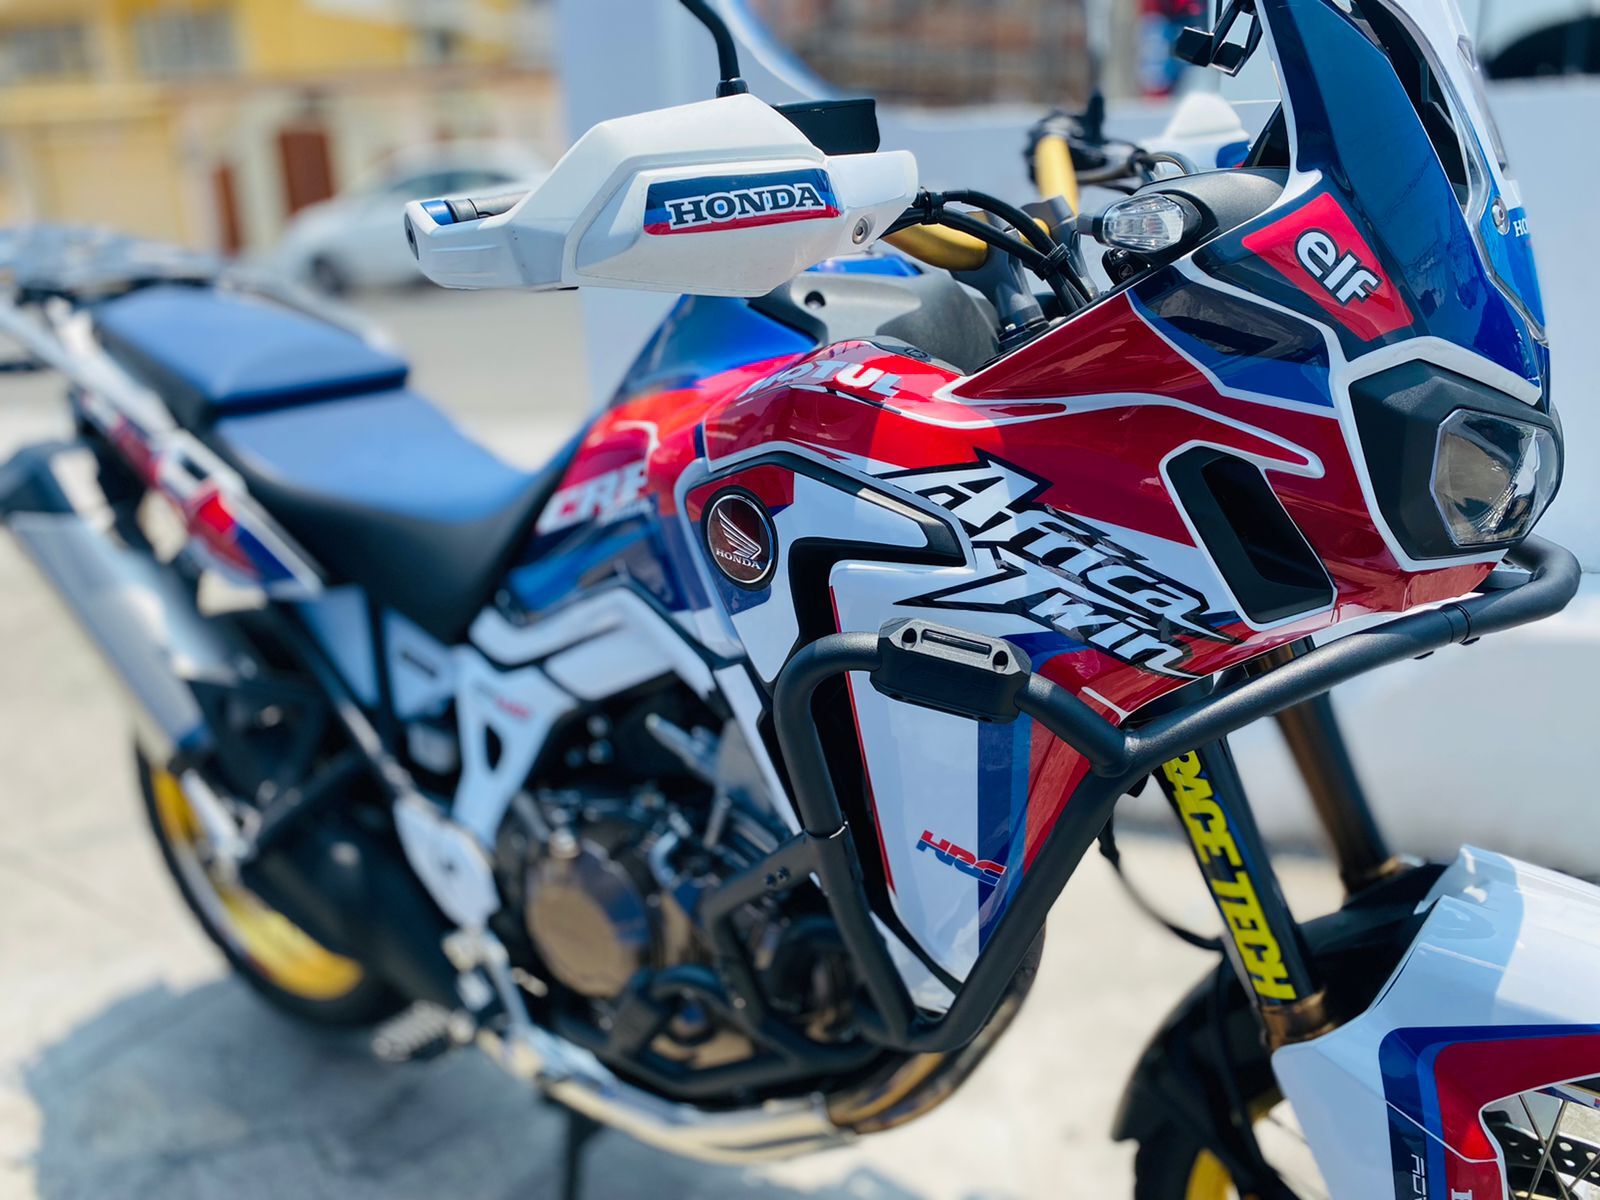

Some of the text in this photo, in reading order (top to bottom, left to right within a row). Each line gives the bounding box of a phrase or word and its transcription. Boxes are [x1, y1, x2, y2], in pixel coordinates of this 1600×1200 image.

[666, 184, 825, 228] HONDA
[1296, 229, 1380, 304] elf
[735, 360, 902, 400] MOTUL
[715, 547, 762, 570] HONDA
[916, 829, 1007, 887] HRC
[1211, 870, 1297, 1000] TECH
